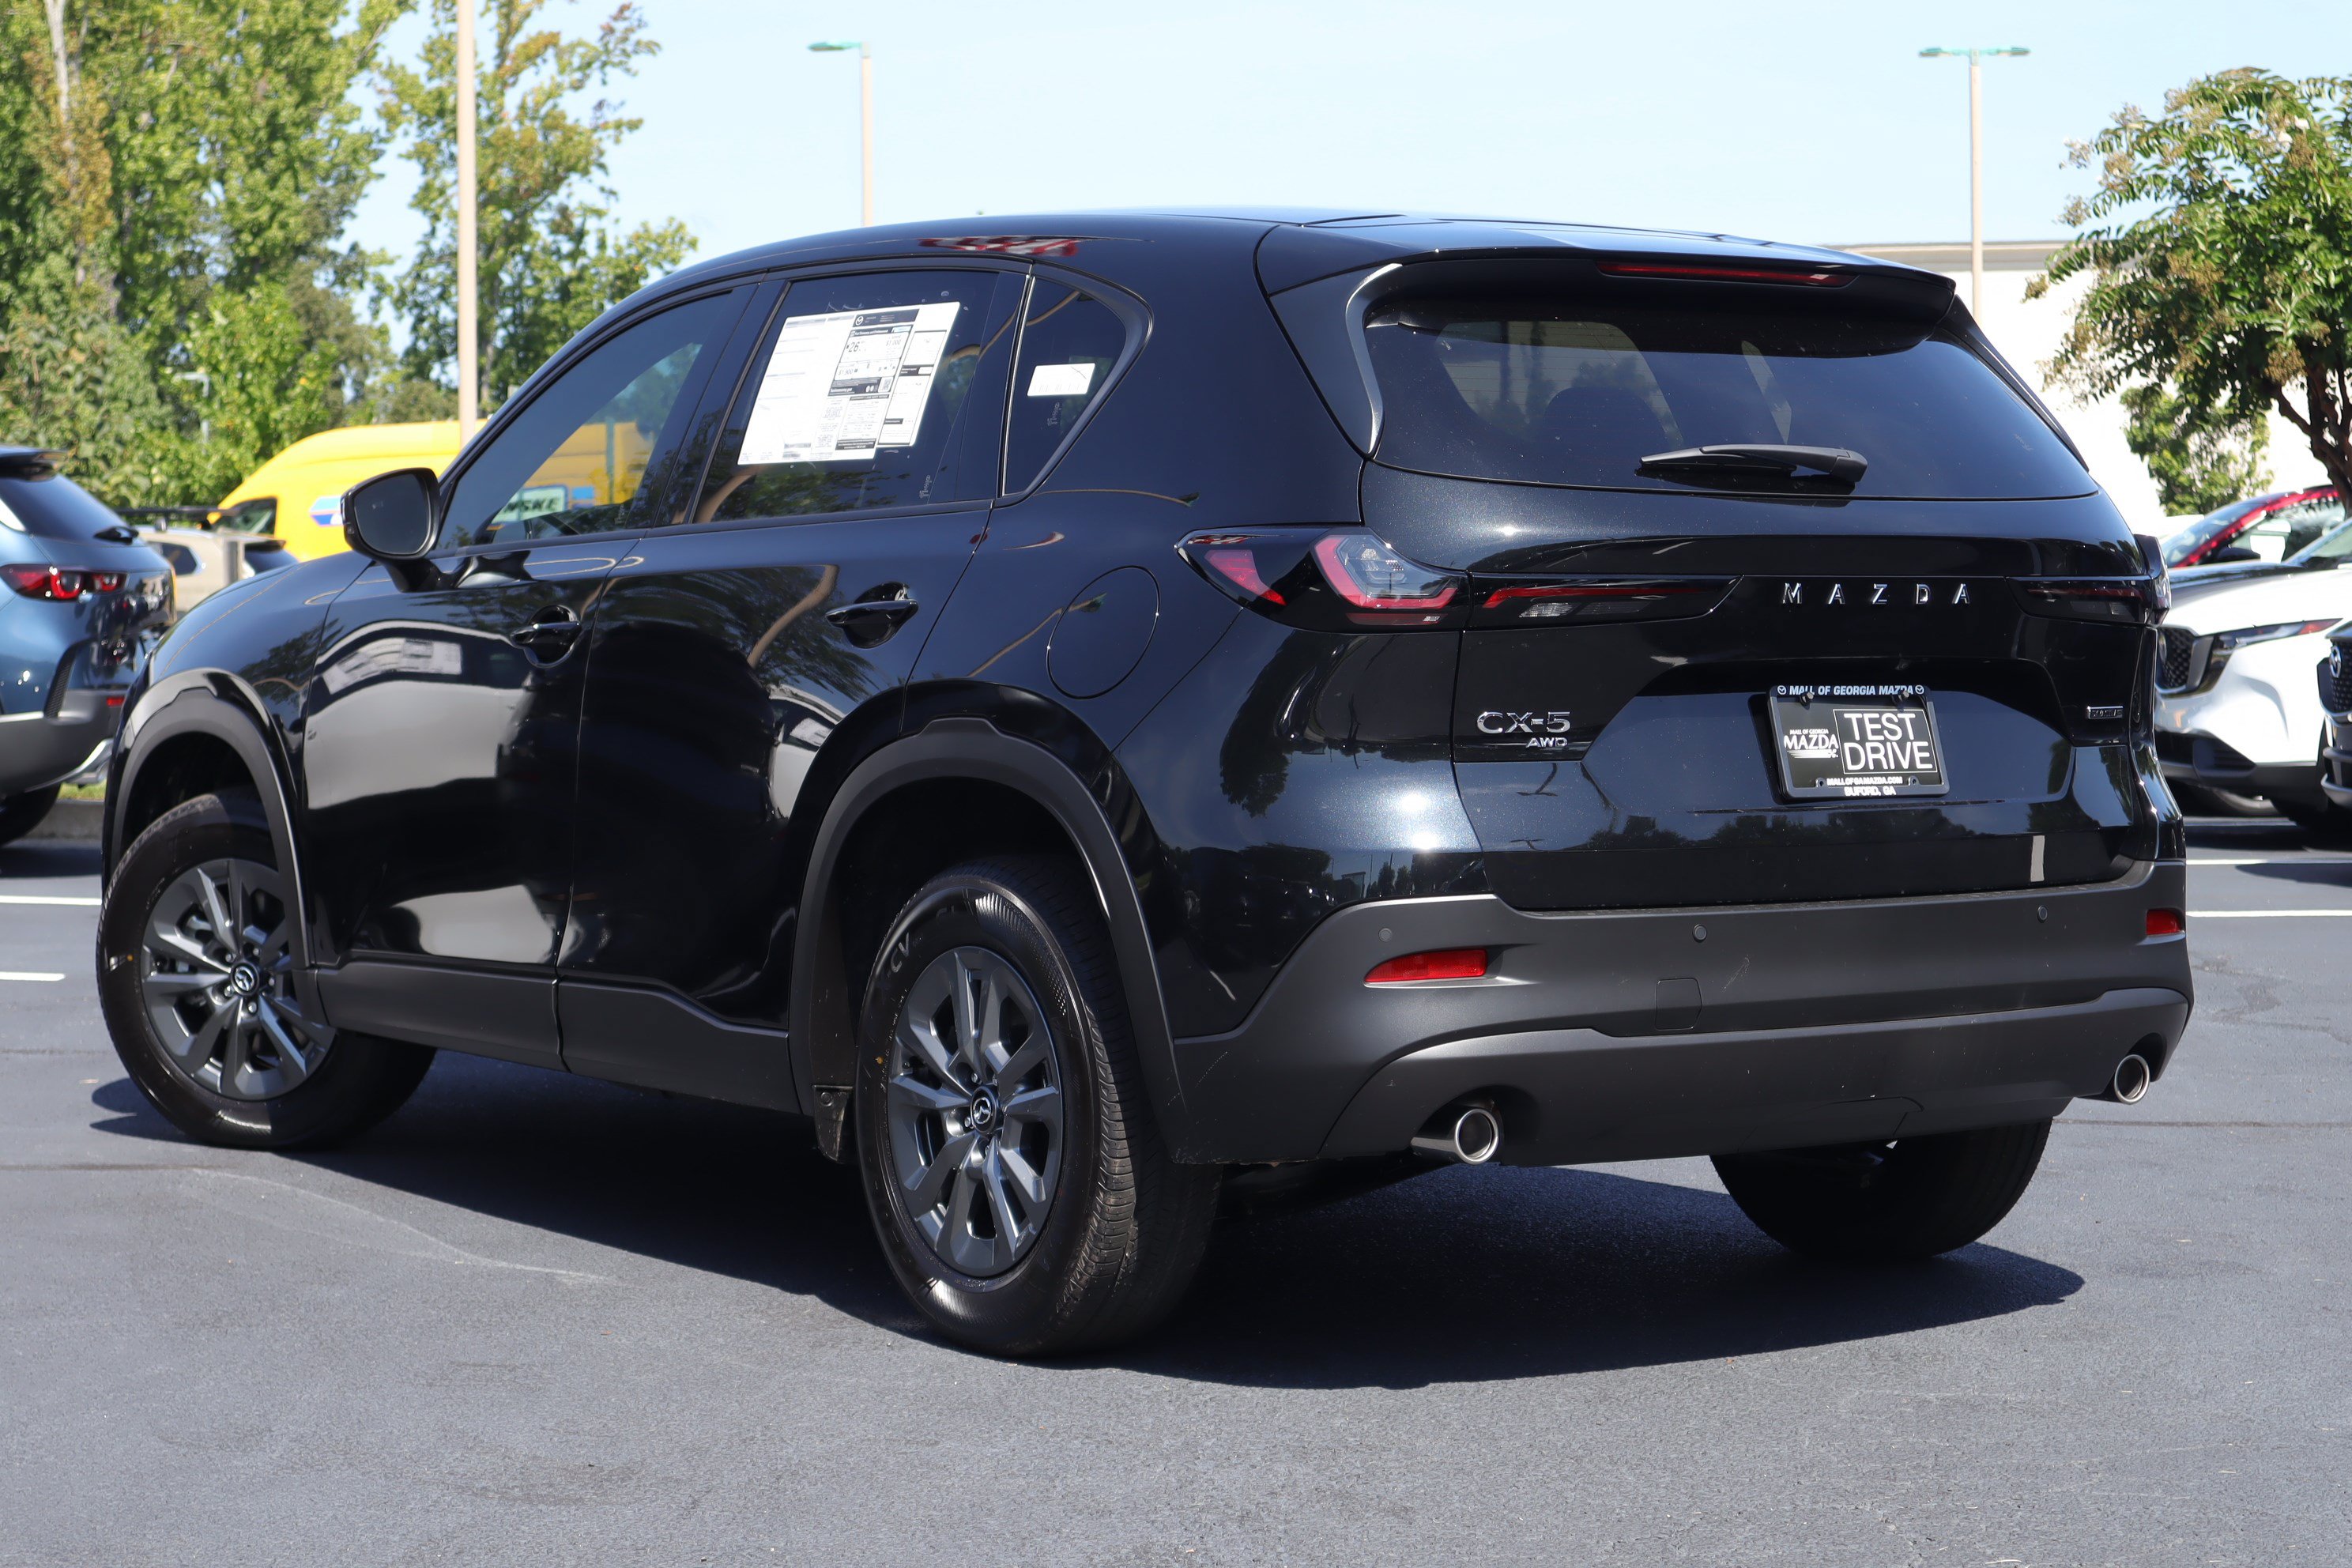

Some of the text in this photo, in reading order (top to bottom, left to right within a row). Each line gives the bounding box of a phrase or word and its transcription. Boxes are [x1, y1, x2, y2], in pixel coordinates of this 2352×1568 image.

[1783, 582, 1970, 605] MAZDA
[1789, 685, 1913, 695] MALL OF GEORGIA MAZDA
[1477, 711, 1570, 734] CX-5
[1843, 713, 1916, 741] TEST
[1525, 737, 1568, 748] AWD
[1783, 734, 1839, 750] MAZDA
[1844, 741, 1933, 771] DRIVE
[1883, 786, 1897, 796] GA
